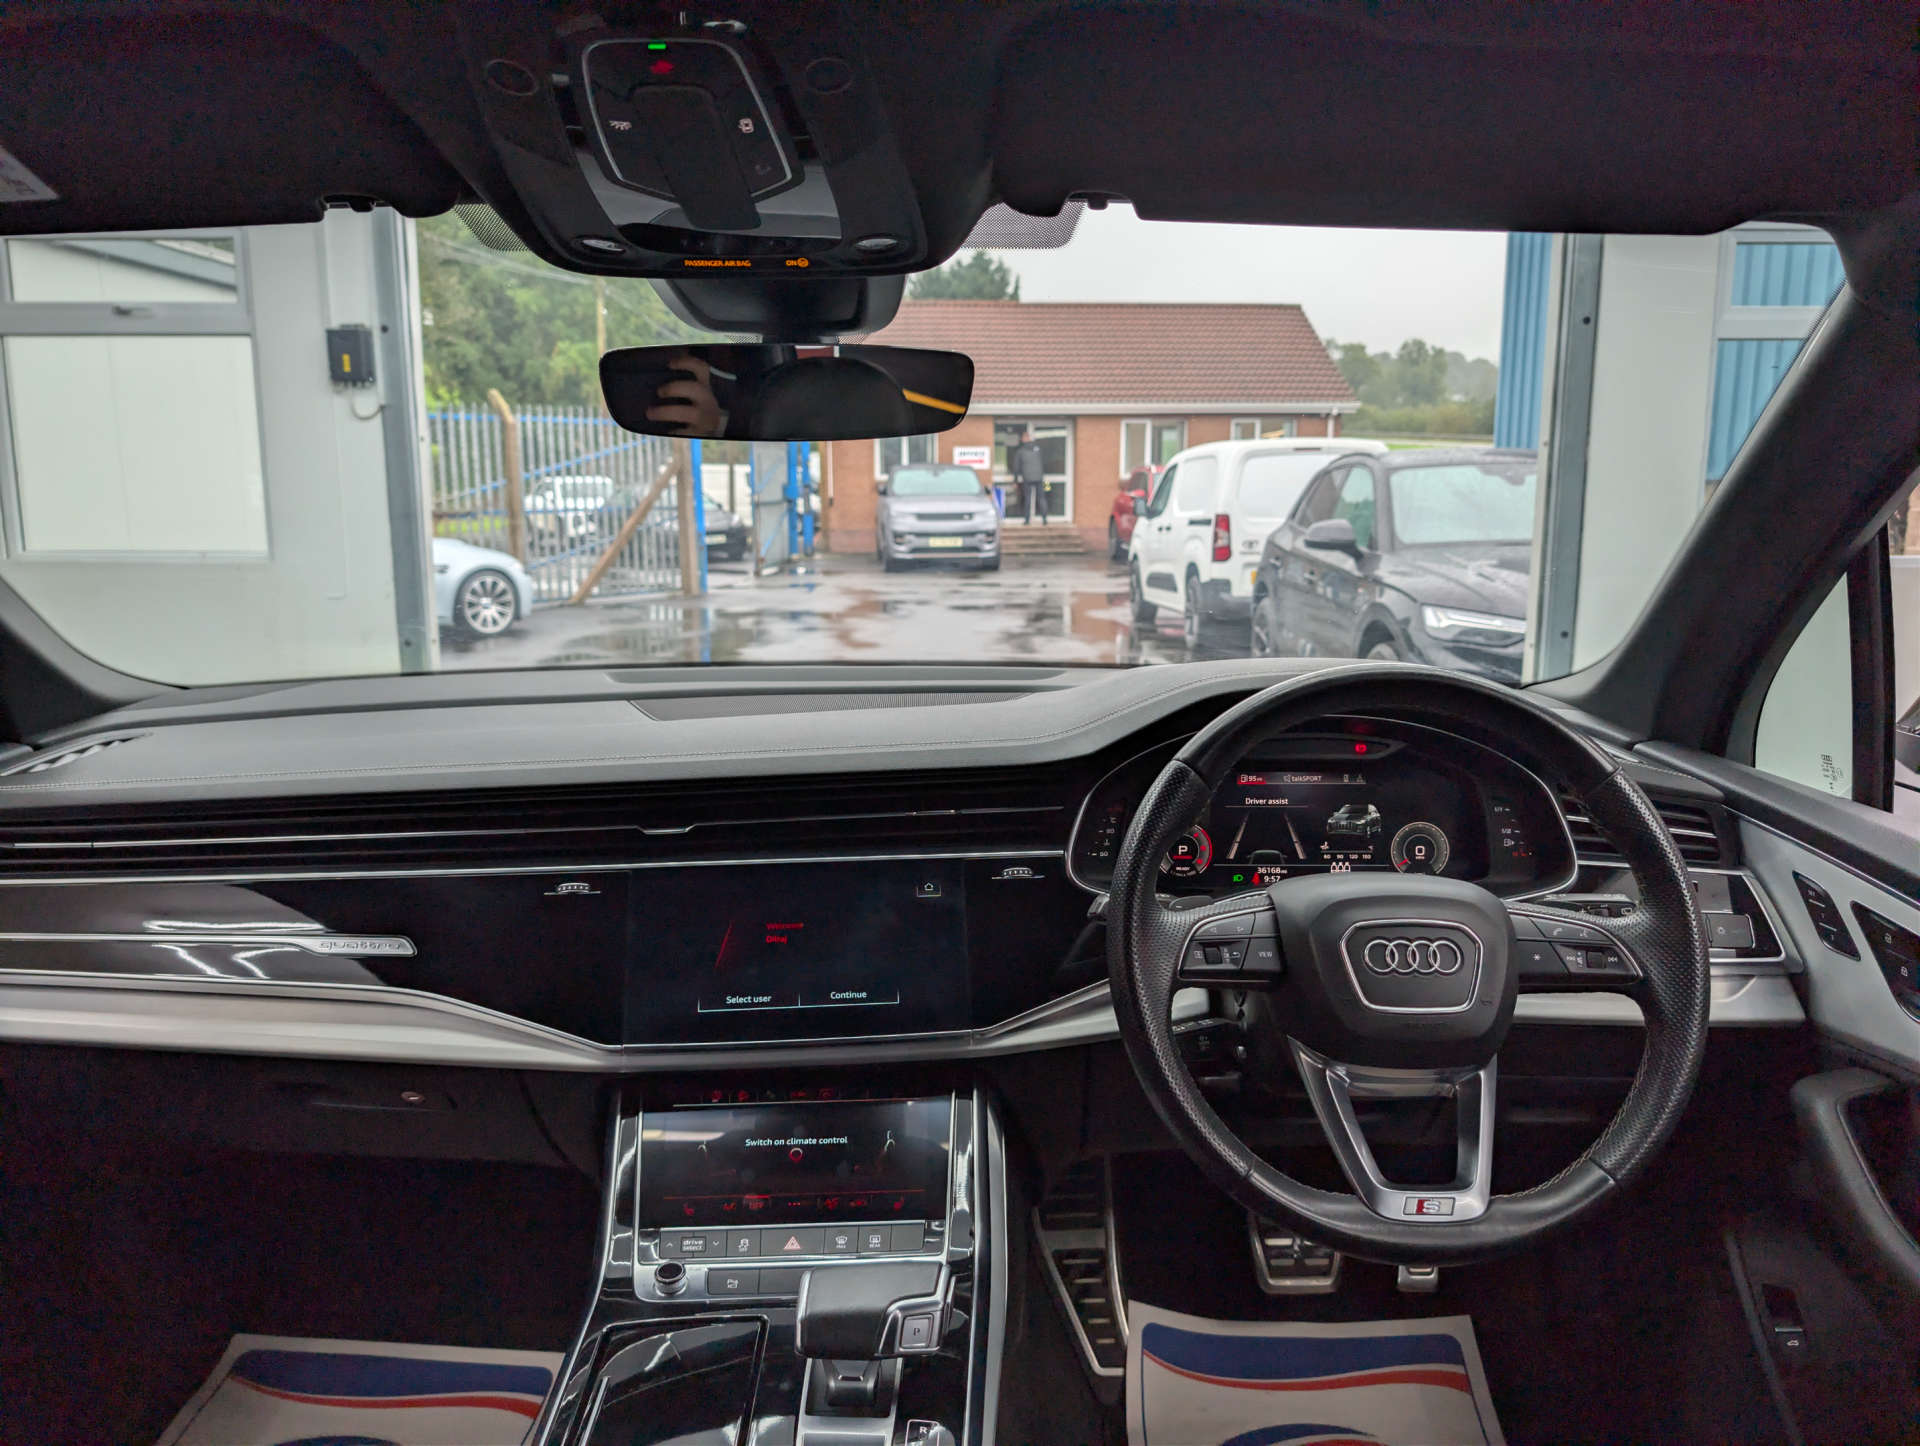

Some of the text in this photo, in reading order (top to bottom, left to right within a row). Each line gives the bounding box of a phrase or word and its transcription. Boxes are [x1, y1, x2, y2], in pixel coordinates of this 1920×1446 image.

[1291, 775, 1322, 783] talkSPORT
[1245, 797, 1288, 805] Driver assist
[1178, 845, 1188, 855] P
[1264, 875, 1280, 883] 9:57
[320, 941, 401, 950] quattro
[830, 990, 867, 999] Continue
[725, 995, 772, 1004] Select user
[745, 1138, 772, 1147] Switch
[786, 1137, 817, 1145] climate
[818, 1136, 848, 1144] control
[913, 1328, 921, 1336] P
[920, 1426, 928, 1434] R
